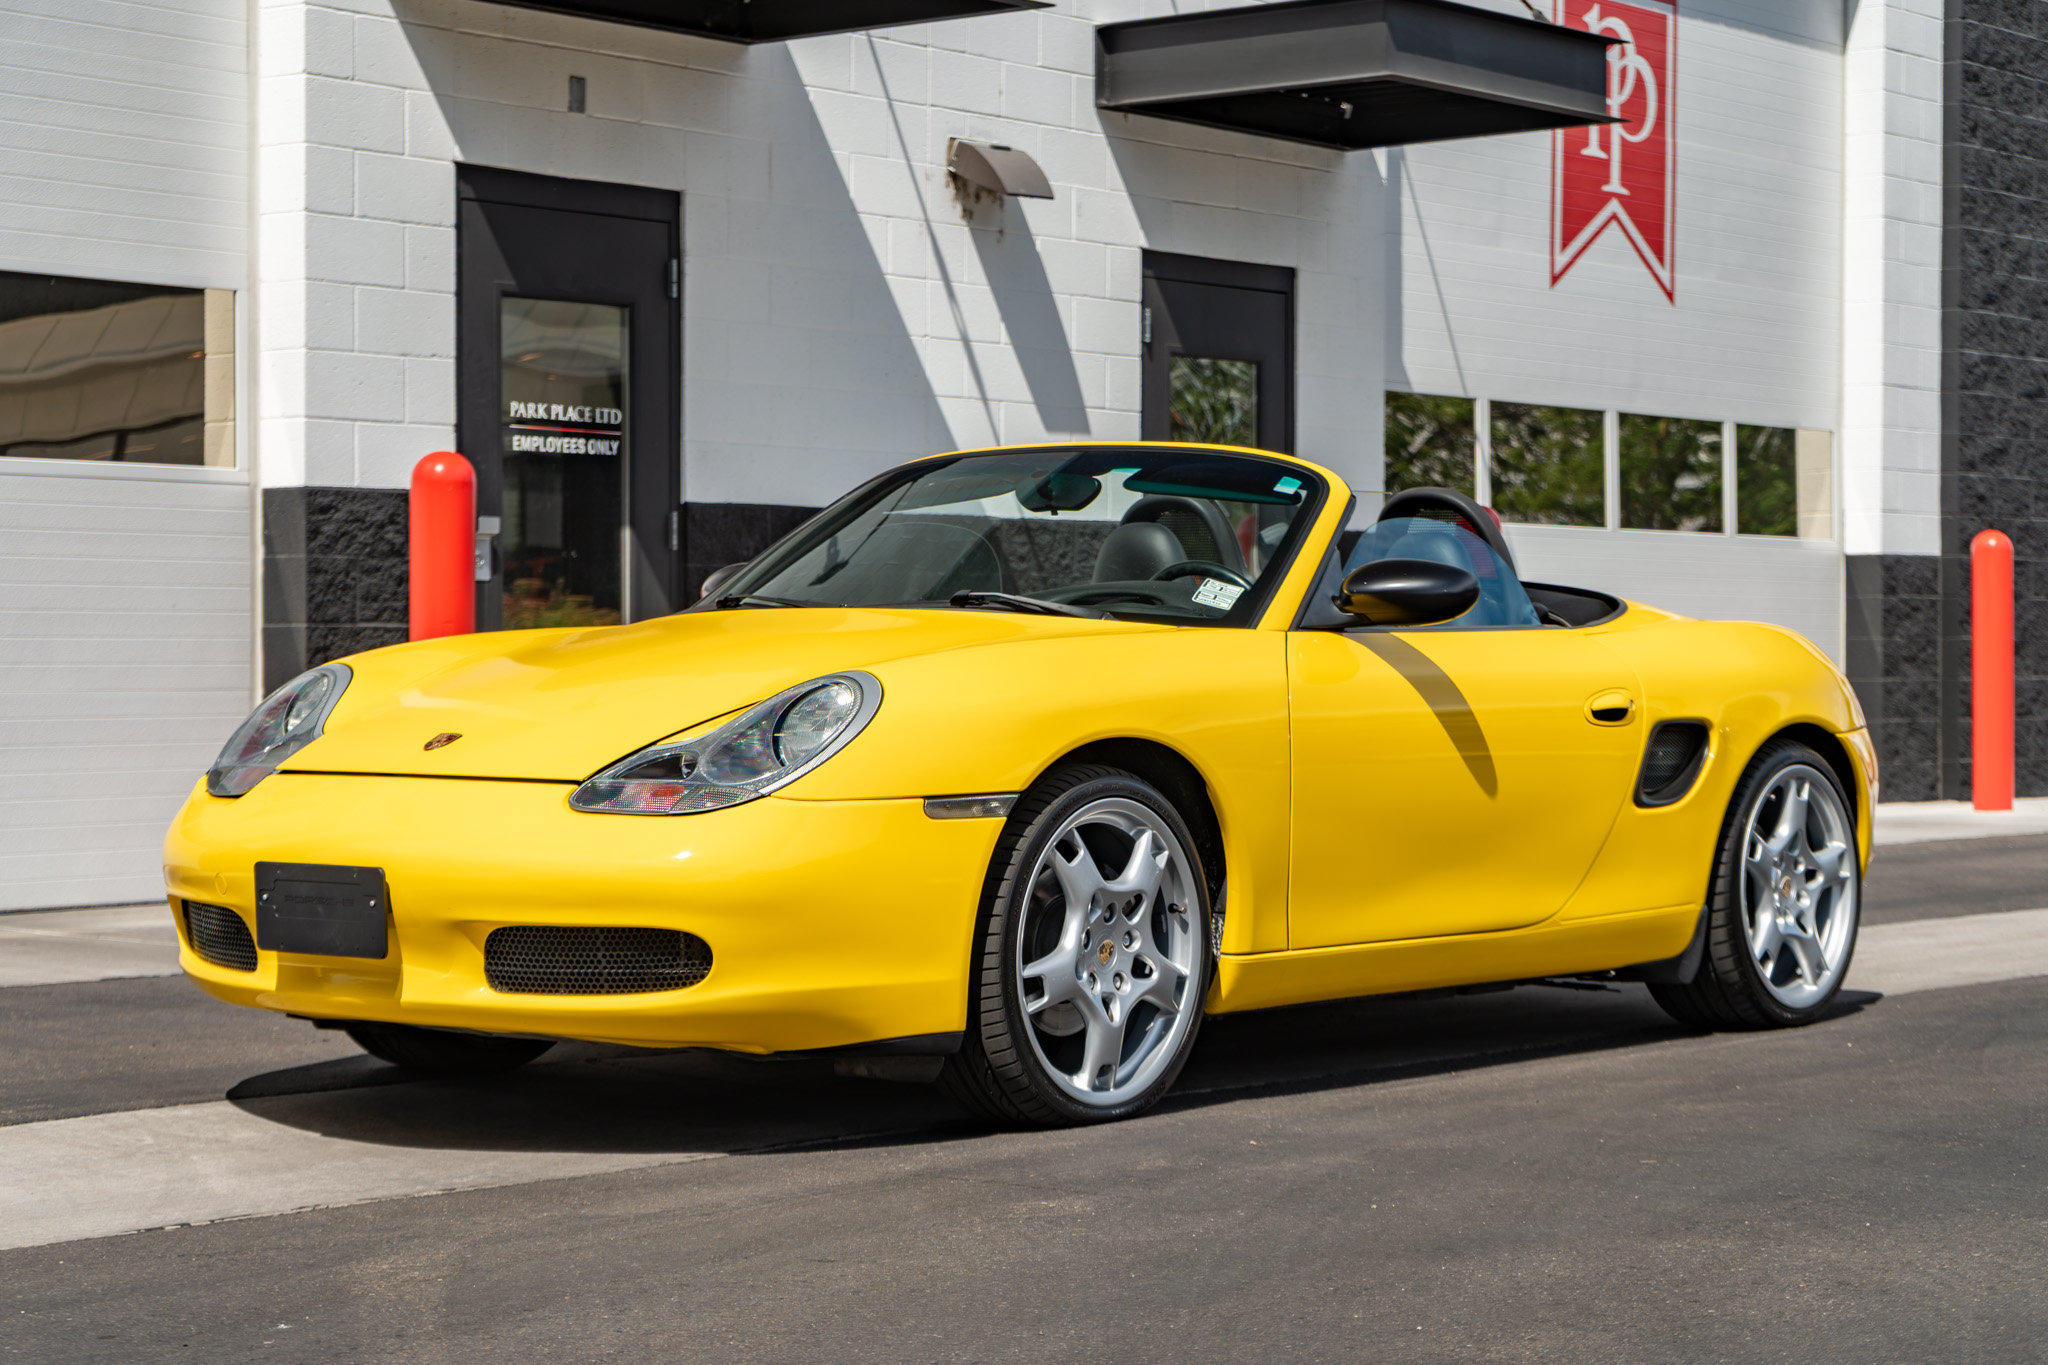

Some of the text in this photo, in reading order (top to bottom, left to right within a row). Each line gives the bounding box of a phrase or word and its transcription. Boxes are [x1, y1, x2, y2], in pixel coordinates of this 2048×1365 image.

[509, 401, 622, 425] PARK PLACE LTD
[512, 434, 620, 456] EMPLOYEES ONLY
